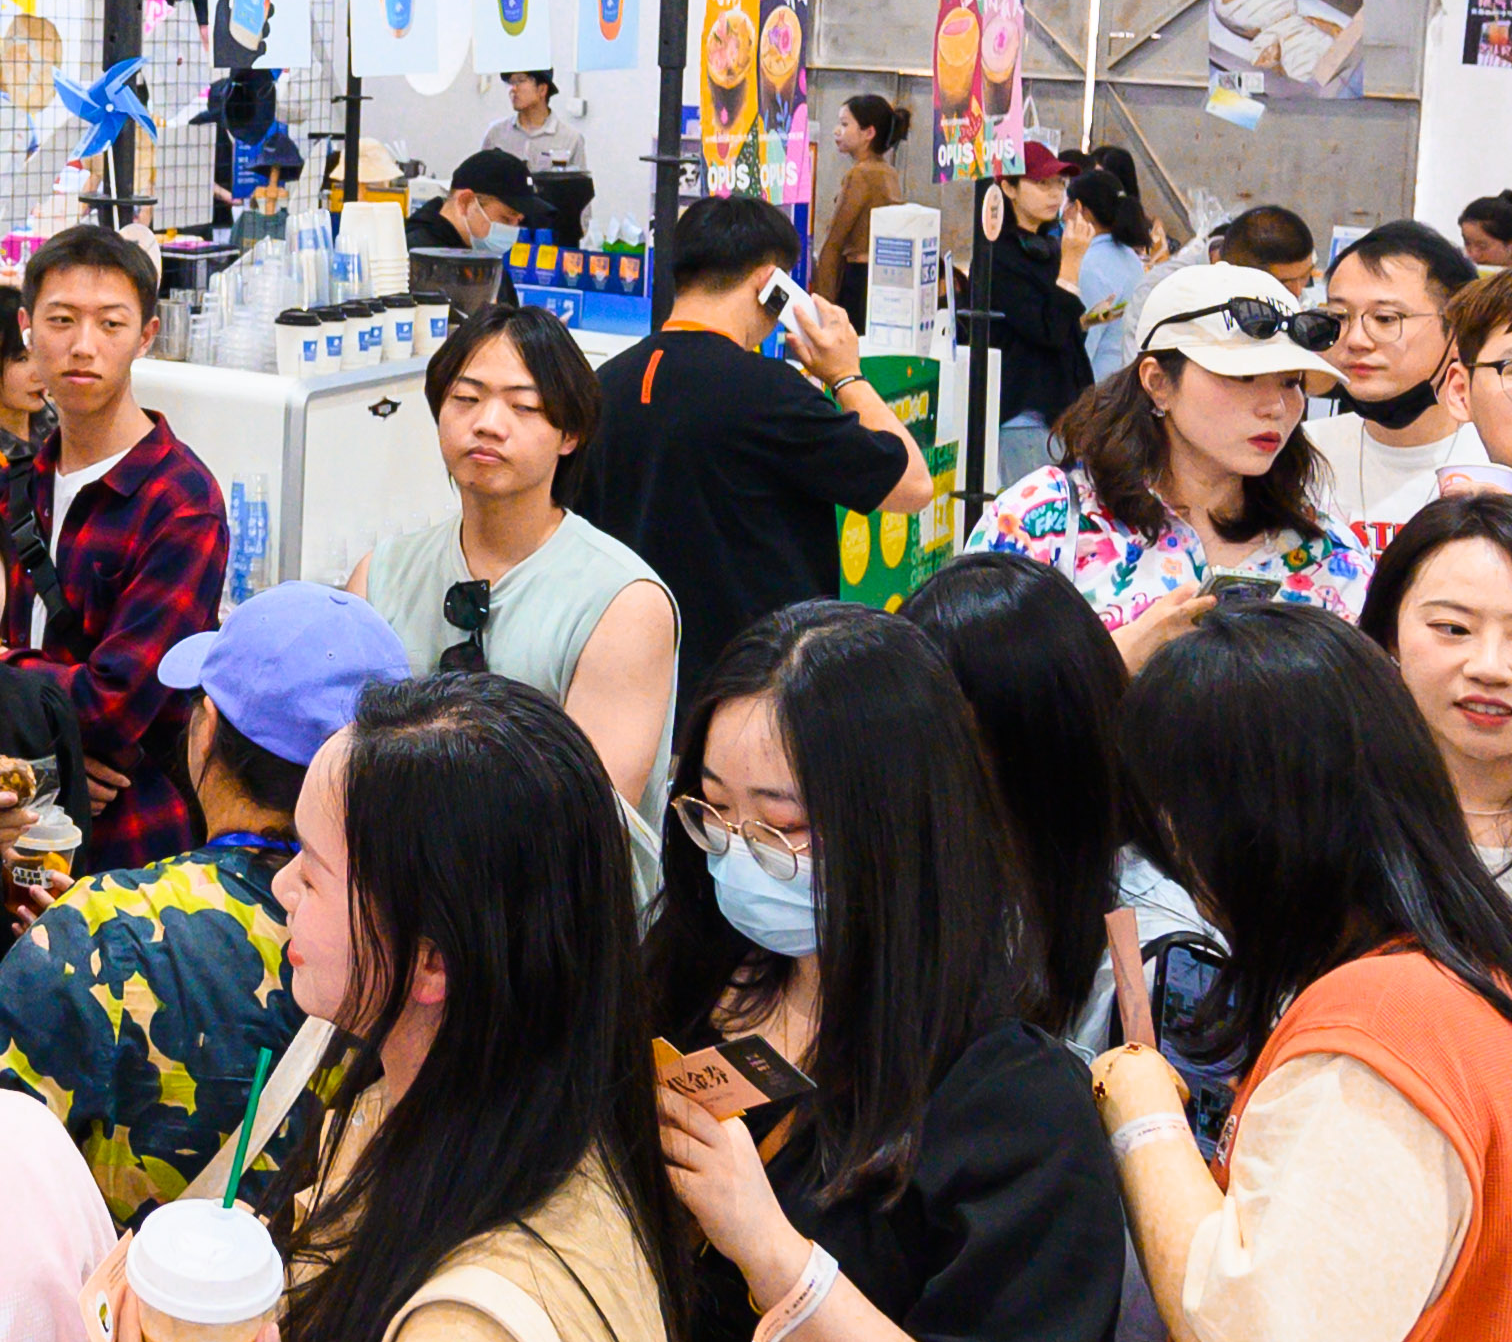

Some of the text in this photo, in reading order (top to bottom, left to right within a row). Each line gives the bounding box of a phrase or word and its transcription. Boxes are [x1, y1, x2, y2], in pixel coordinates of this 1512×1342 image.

[938, 141, 974, 167] OPUS
[982, 139, 1015, 161] OPUS
[707, 163, 750, 193] OPUS
[760, 160, 798, 189] OPUS
